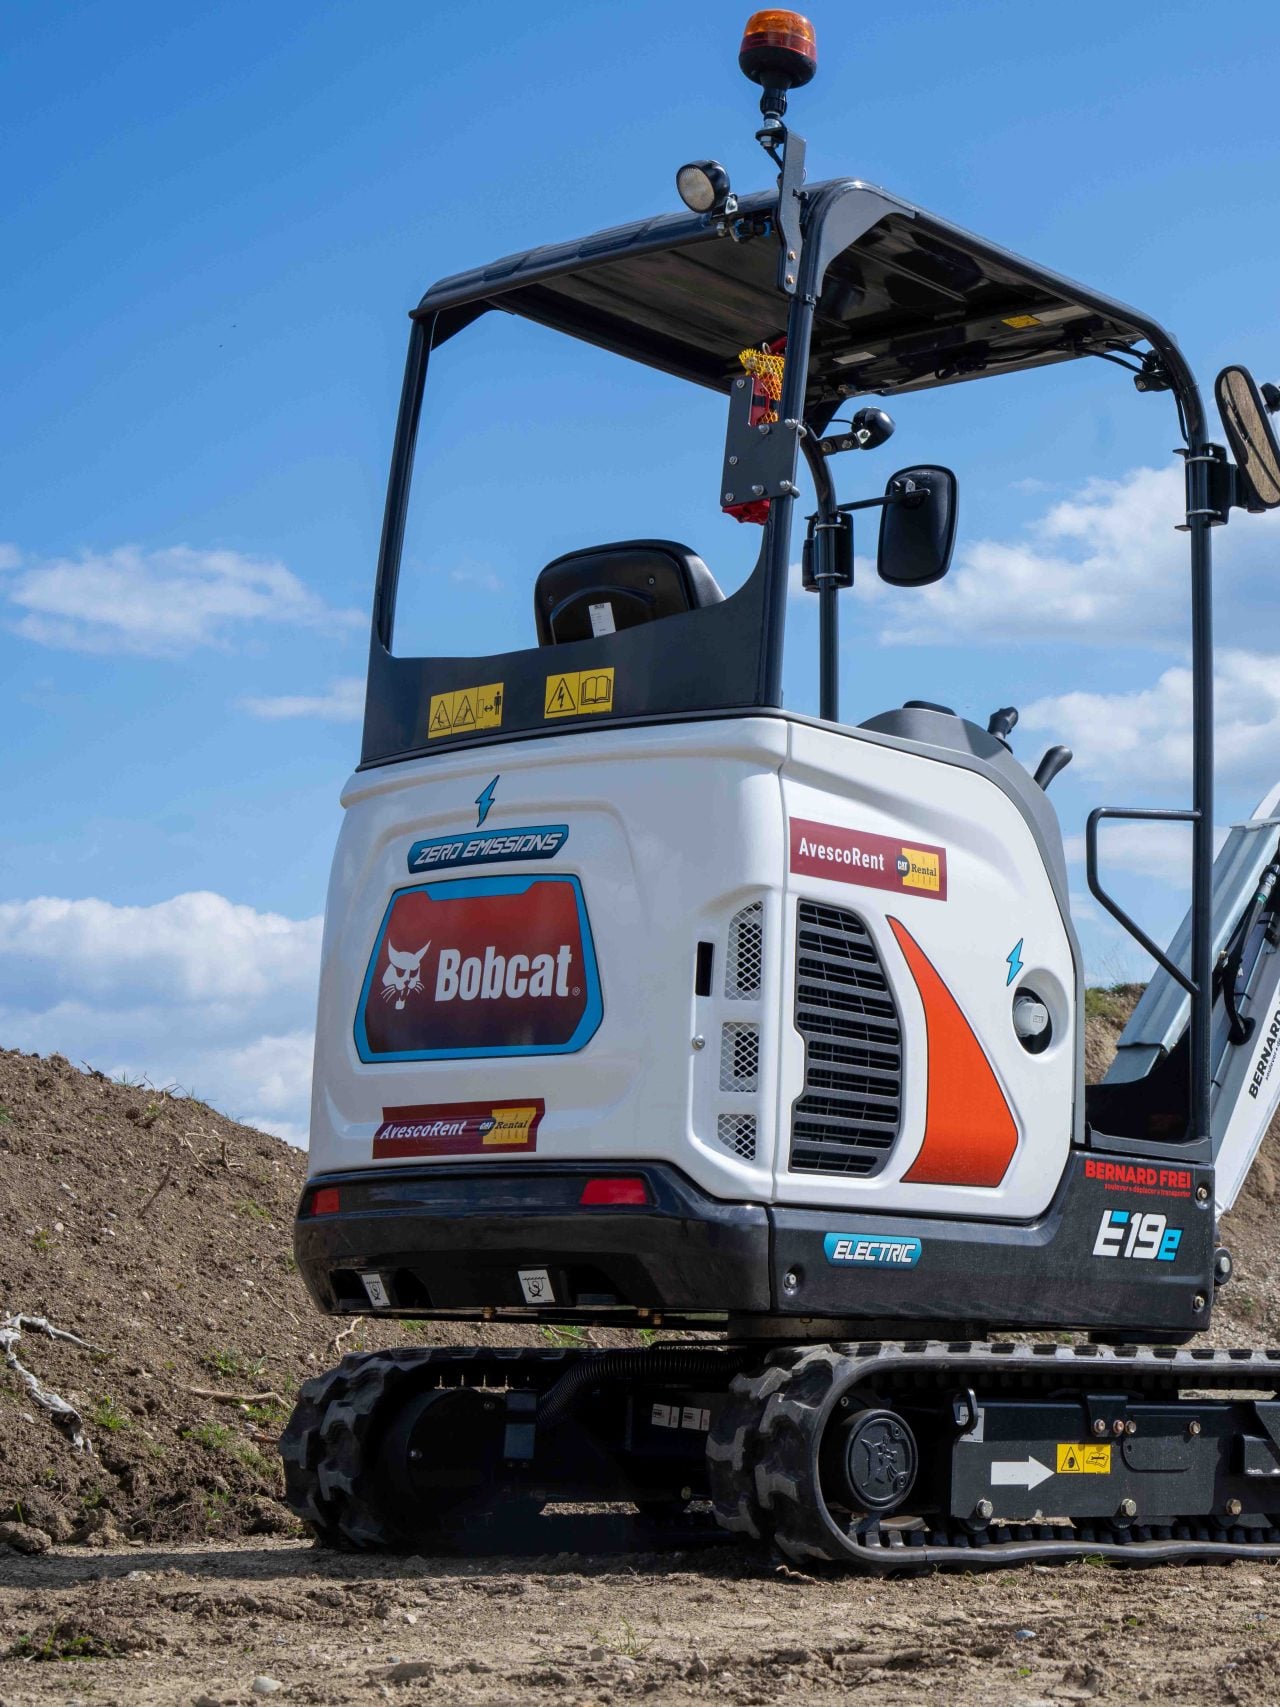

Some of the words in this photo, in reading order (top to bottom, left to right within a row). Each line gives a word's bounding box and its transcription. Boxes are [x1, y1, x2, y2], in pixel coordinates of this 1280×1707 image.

[414, 842, 463, 866] ZERO
[462, 833, 563, 858] EMISSIONS
[799, 837, 885, 871] AvescoRent
[897, 860, 908, 872] CAT
[911, 863, 937, 877] Rental
[380, 1120, 468, 1140] AvescoRent
[495, 1119, 528, 1130] Rental
[1085, 1160, 1158, 1186] BERNARD
[1159, 1170, 1191, 1189] FREI
[833, 1240, 916, 1263] ELECTRIC
